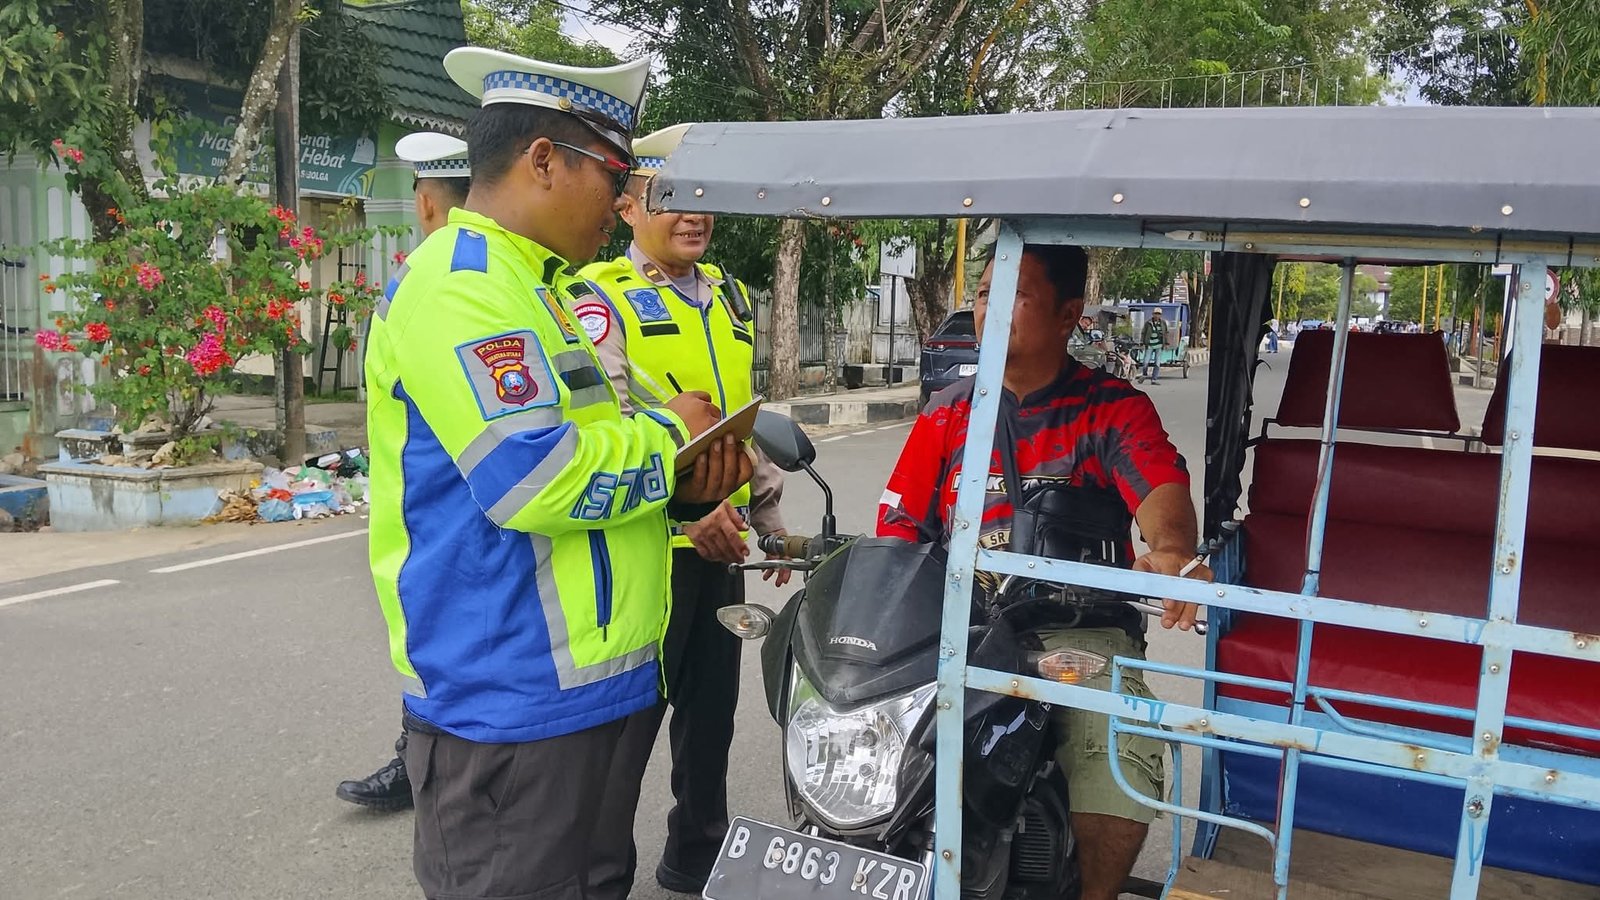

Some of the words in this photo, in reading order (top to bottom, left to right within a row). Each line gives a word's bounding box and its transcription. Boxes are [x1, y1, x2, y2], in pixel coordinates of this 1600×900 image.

[300, 147, 346, 168] Hebat
[476, 339, 521, 356] POLDA
[828, 635, 878, 651] HONDA
[727, 826, 751, 859] B
[763, 836, 841, 885] 6863
[850, 857, 916, 900] KZR
